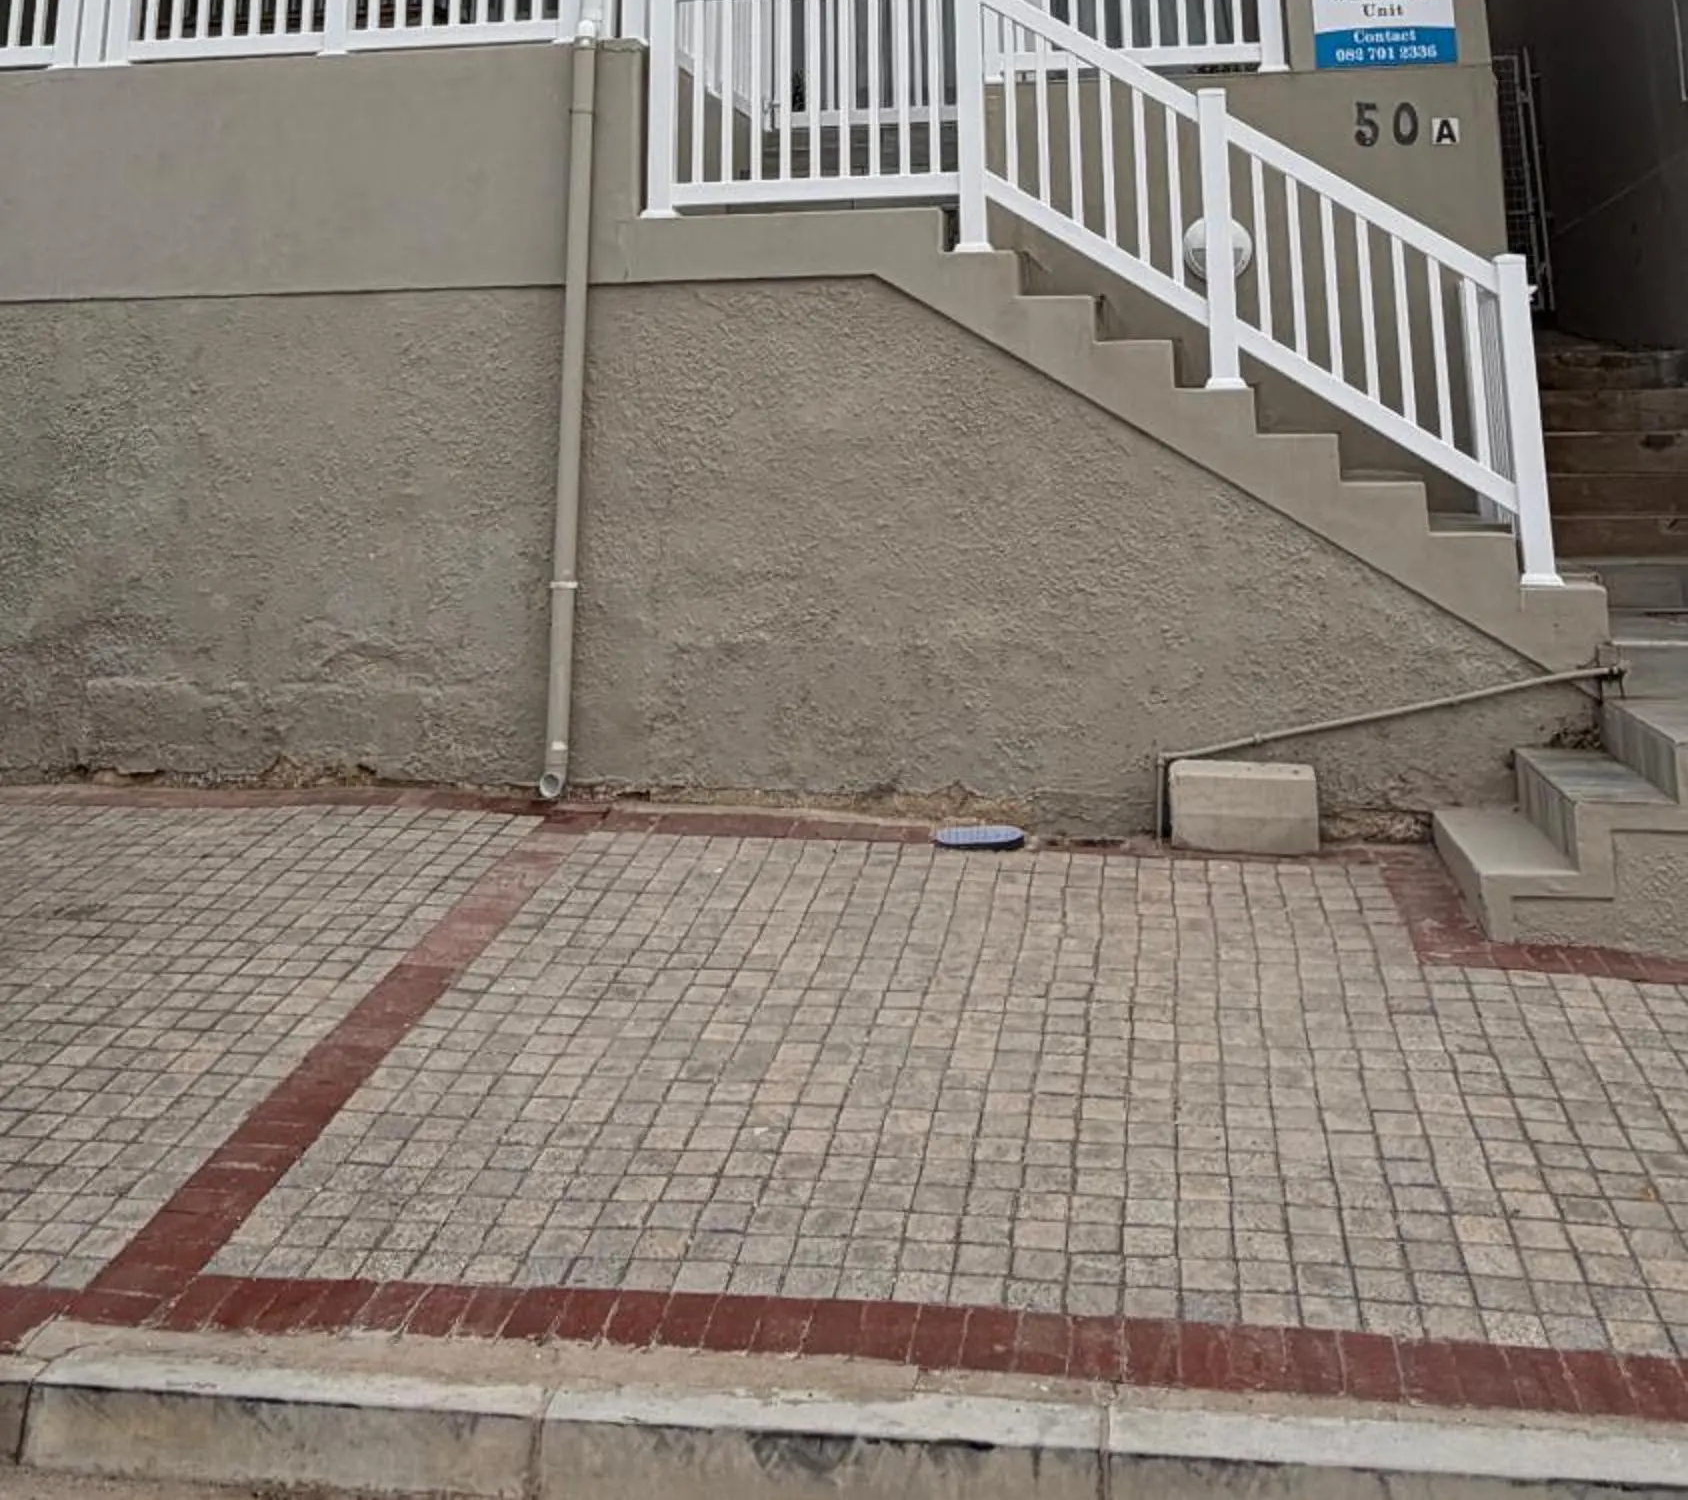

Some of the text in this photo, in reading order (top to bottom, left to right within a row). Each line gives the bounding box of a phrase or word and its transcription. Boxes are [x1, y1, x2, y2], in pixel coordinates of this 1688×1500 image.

[1363, 3, 1404, 18] Unit
[1353, 29, 1416, 43] Contact
[1368, 48, 1394, 61] 701
[1355, 101, 1457, 147] 50 A
